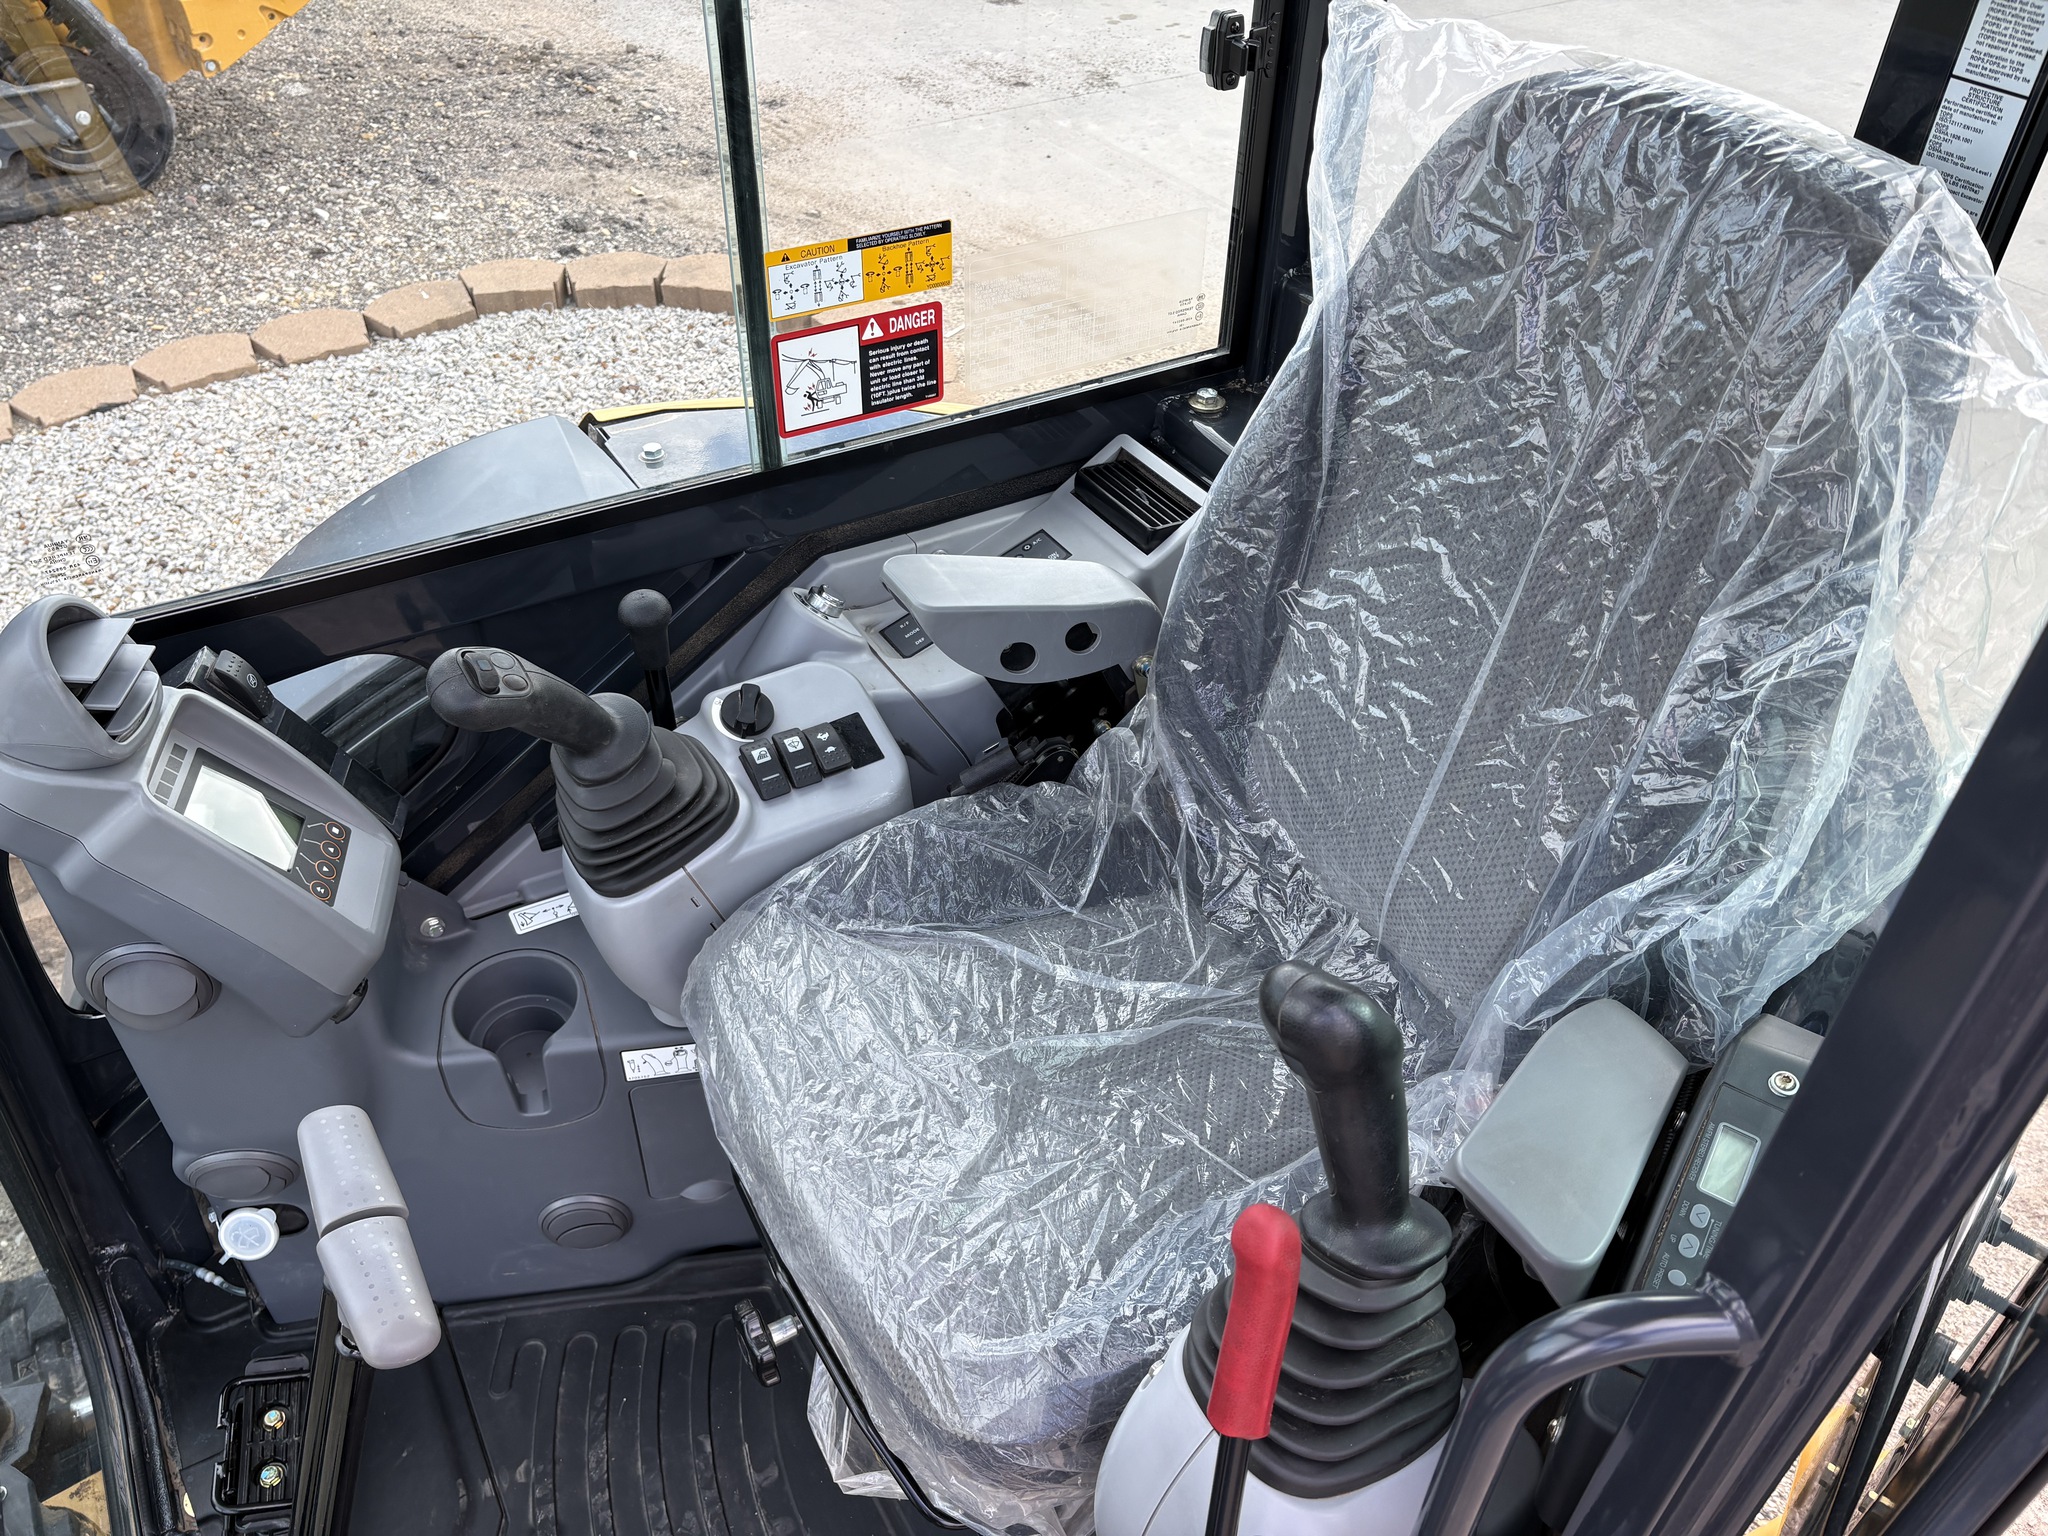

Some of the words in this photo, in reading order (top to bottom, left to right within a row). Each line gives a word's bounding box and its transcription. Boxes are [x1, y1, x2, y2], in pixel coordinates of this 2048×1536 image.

[1991, 0, 2018, 12] Protective
[2019, 6, 2045, 19] Structure
[1983, 19, 2002, 30] (FOPS)
[2021, 29, 2034, 37] Over
[1986, 13, 2012, 26] Protective
[2013, 20, 2039, 33] Structure
[1978, 32, 1996, 43] (TOPS)
[1997, 38, 2011, 46] must
[1981, 26, 2008, 39] Protective
[2008, 34, 2034, 46] Structure
[1985, 41, 2008, 53] repaired
[1972, 48, 1982, 56] Any
[1983, 51, 2008, 63] alteration
[1965, 67, 2001, 83] manufacturer.
[1968, 61, 1980, 69] must
[1988, 67, 2013, 79] approved
[2009, 65, 2024, 74] TOPS
[1968, 92, 2001, 107] STRUCTURE
[1969, 87, 2004, 101] PROTECTIVE
[1944, 98, 1975, 112] Performance
[1975, 108, 1997, 119] certified
[1961, 96, 2003, 114] CERTIFICATION
[1939, 110, 1953, 119] TOPS
[1959, 110, 1990, 123] manufacture
[1960, 163, 1989, 177] Guard-Level
[1954, 176, 1984, 191] Certification
[923, 223, 942, 231] PATTERN
[857, 241, 877, 249] SELECTED
[885, 235, 908, 243] OPERATING
[883, 243, 906, 252] Backhoe
[908, 238, 929, 247] Pattern
[801, 245, 835, 258] CAUTION
[786, 259, 817, 271] Excavator
[820, 255, 843, 264] Pattern
[889, 309, 935, 334] DANGER
[869, 347, 889, 356] Serious
[891, 343, 905, 352] injury
[914, 338, 928, 346] death
[880, 353, 895, 361] result
[910, 346, 929, 354] contact
[883, 359, 902, 367] electric
[870, 370, 885, 378] Never
[871, 383, 891, 392] electric
[872, 397, 894, 406] insulator
[896, 392, 913, 401] length.
[905, 627, 920, 638] MODE
[915, 637, 925, 645] DEF
[1698, 1138, 1710, 1157] STEREO
[1688, 1157, 1702, 1181] RECEIVER
[1679, 1200, 1690, 1217] DOWN
[1670, 1234, 1677, 1243] UP
[1703, 1220, 1722, 1259] TUNING/TIME
[1660, 1252, 1670, 1268] AUTO
[1653, 1267, 1665, 1289] PRESET
